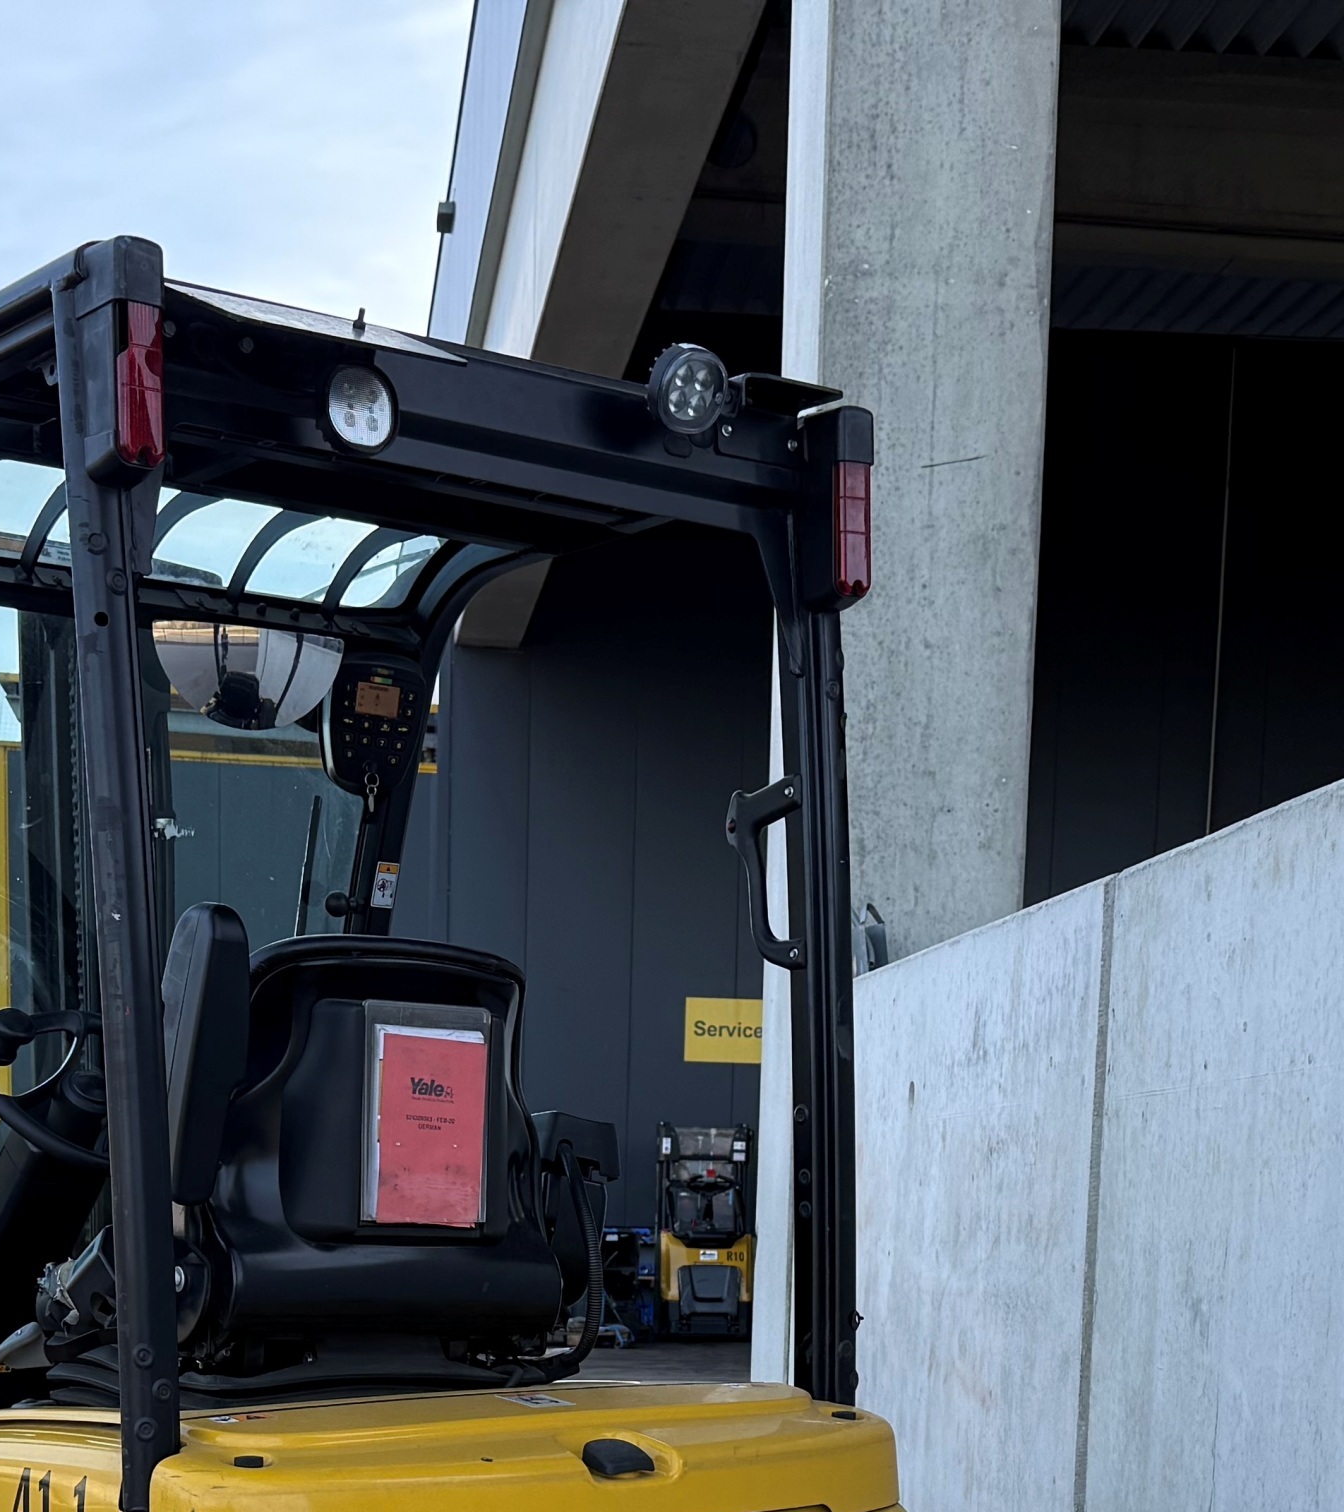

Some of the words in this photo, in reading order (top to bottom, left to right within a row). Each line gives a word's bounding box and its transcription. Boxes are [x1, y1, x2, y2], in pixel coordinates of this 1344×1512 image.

[693, 1020, 763, 1039] Service
[410, 1077, 445, 1098] Yale
[726, 1251, 746, 1262] R10
